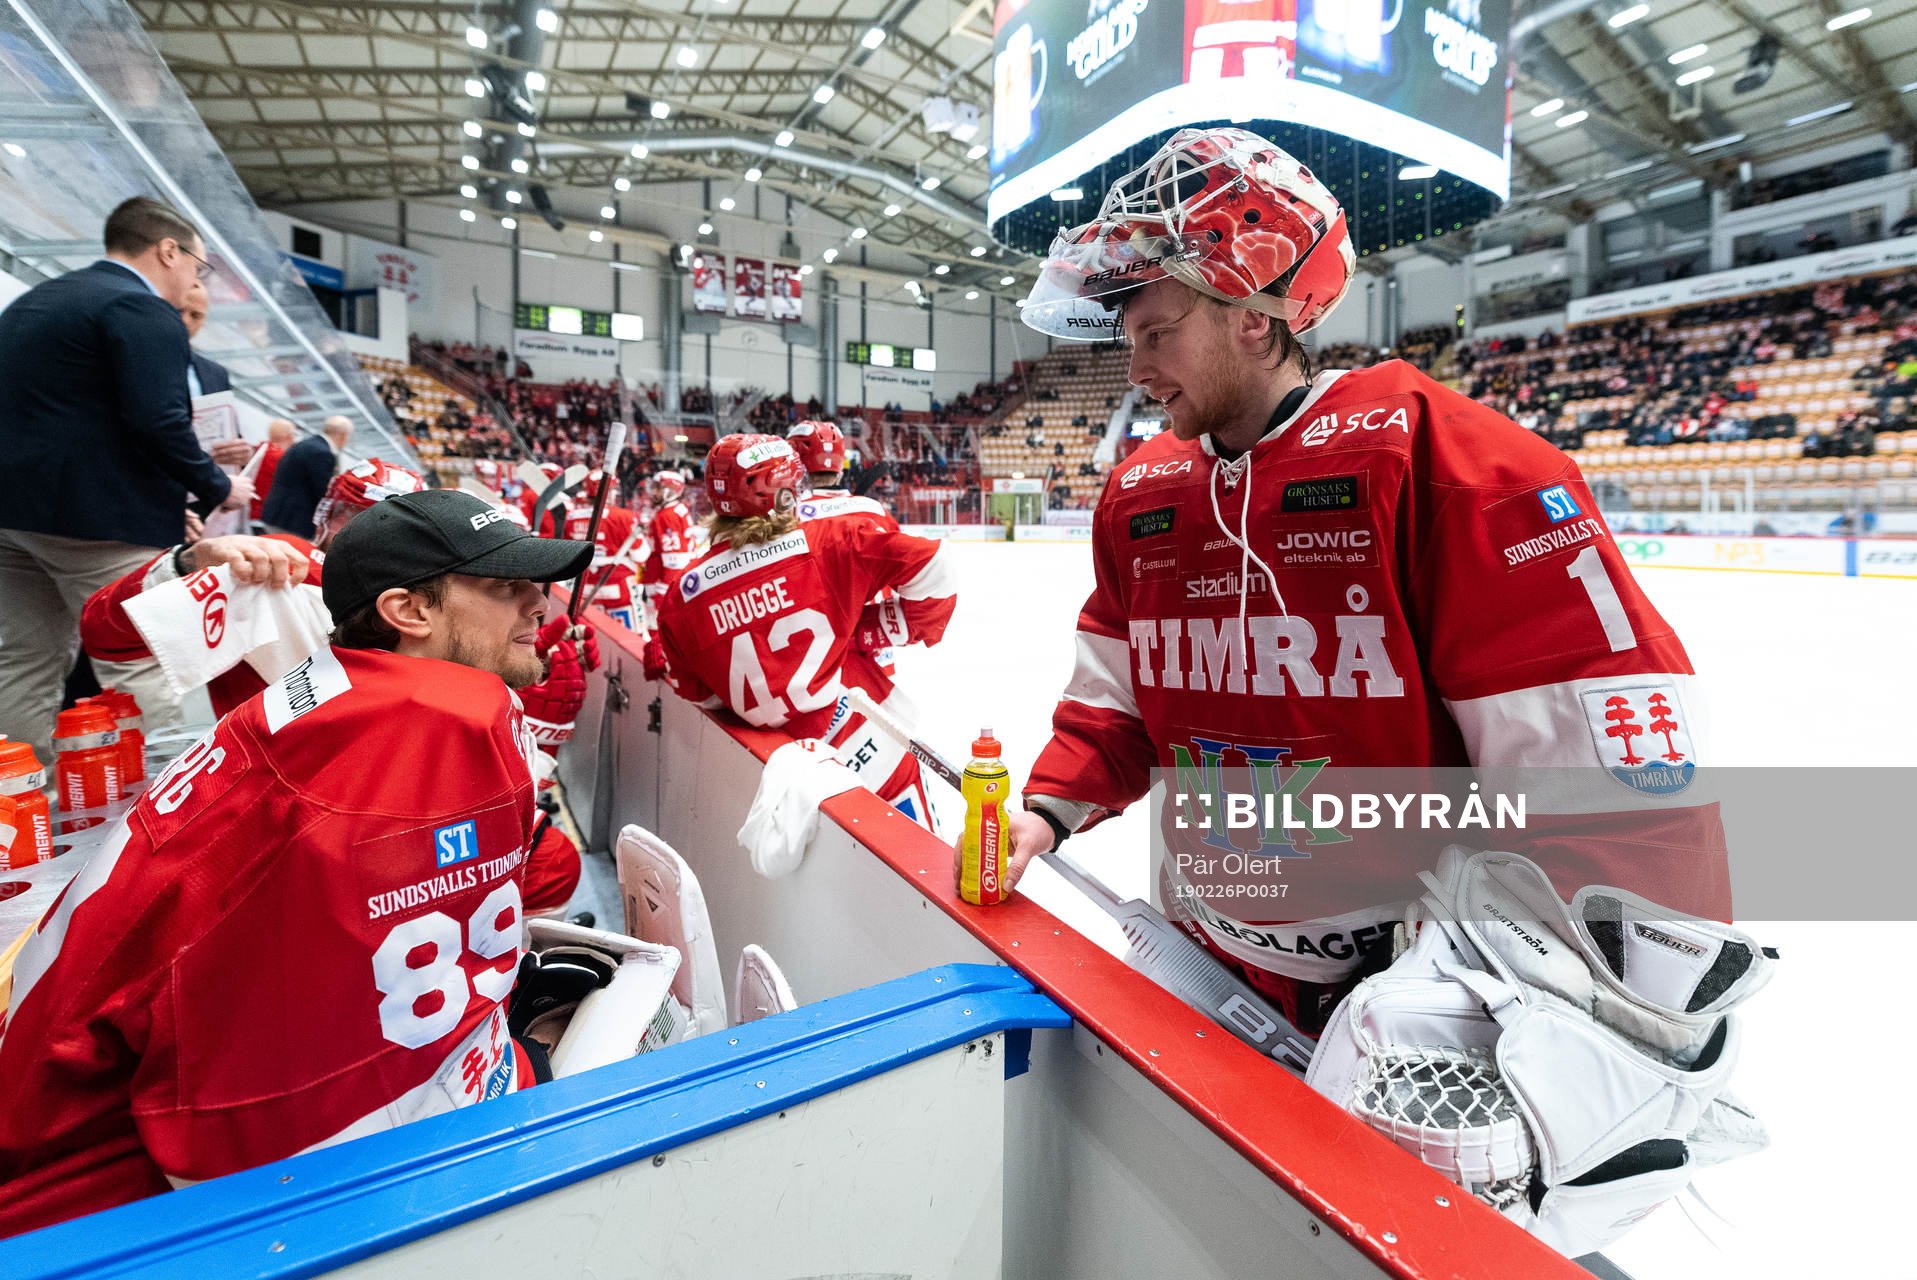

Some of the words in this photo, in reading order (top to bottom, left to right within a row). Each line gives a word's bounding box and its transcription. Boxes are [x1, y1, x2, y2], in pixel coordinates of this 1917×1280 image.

[1083, 257, 1163, 286] BAUER
[1342, 408, 1410, 435] SCA
[1146, 459, 1193, 478] SCA
[1303, 494, 1341, 507] HUSET
[1542, 487, 1576, 519] ST
[661, 533, 681, 551] 23
[1203, 535, 1244, 551] BAUE
[1277, 530, 1371, 550] JOWIC
[1503, 521, 1592, 566] SUNDSVALLS
[704, 557, 742, 581] Grant
[740, 535, 806, 565] Thornton
[1142, 558, 1176, 571] CASTELLUM
[1284, 552, 1343, 564] elteknik
[1346, 552, 1366, 563] ab
[1186, 571, 1267, 599] stadium
[1565, 545, 1637, 653] 1
[708, 576, 794, 635] DRUGGE
[1128, 583, 1405, 698] TIMRÅ
[729, 607, 842, 729] 42
[1628, 766, 1672, 788] TIMRÅ
[1672, 769, 1687, 786] IK
[438, 823, 473, 864] ST
[985, 819, 998, 871] ENERVIT
[367, 866, 477, 919] SUNDSVALLS
[1482, 903, 1549, 957] BRATTSTRÖM
[1640, 929, 1701, 956] BAUER
[371, 879, 523, 1050] 89
